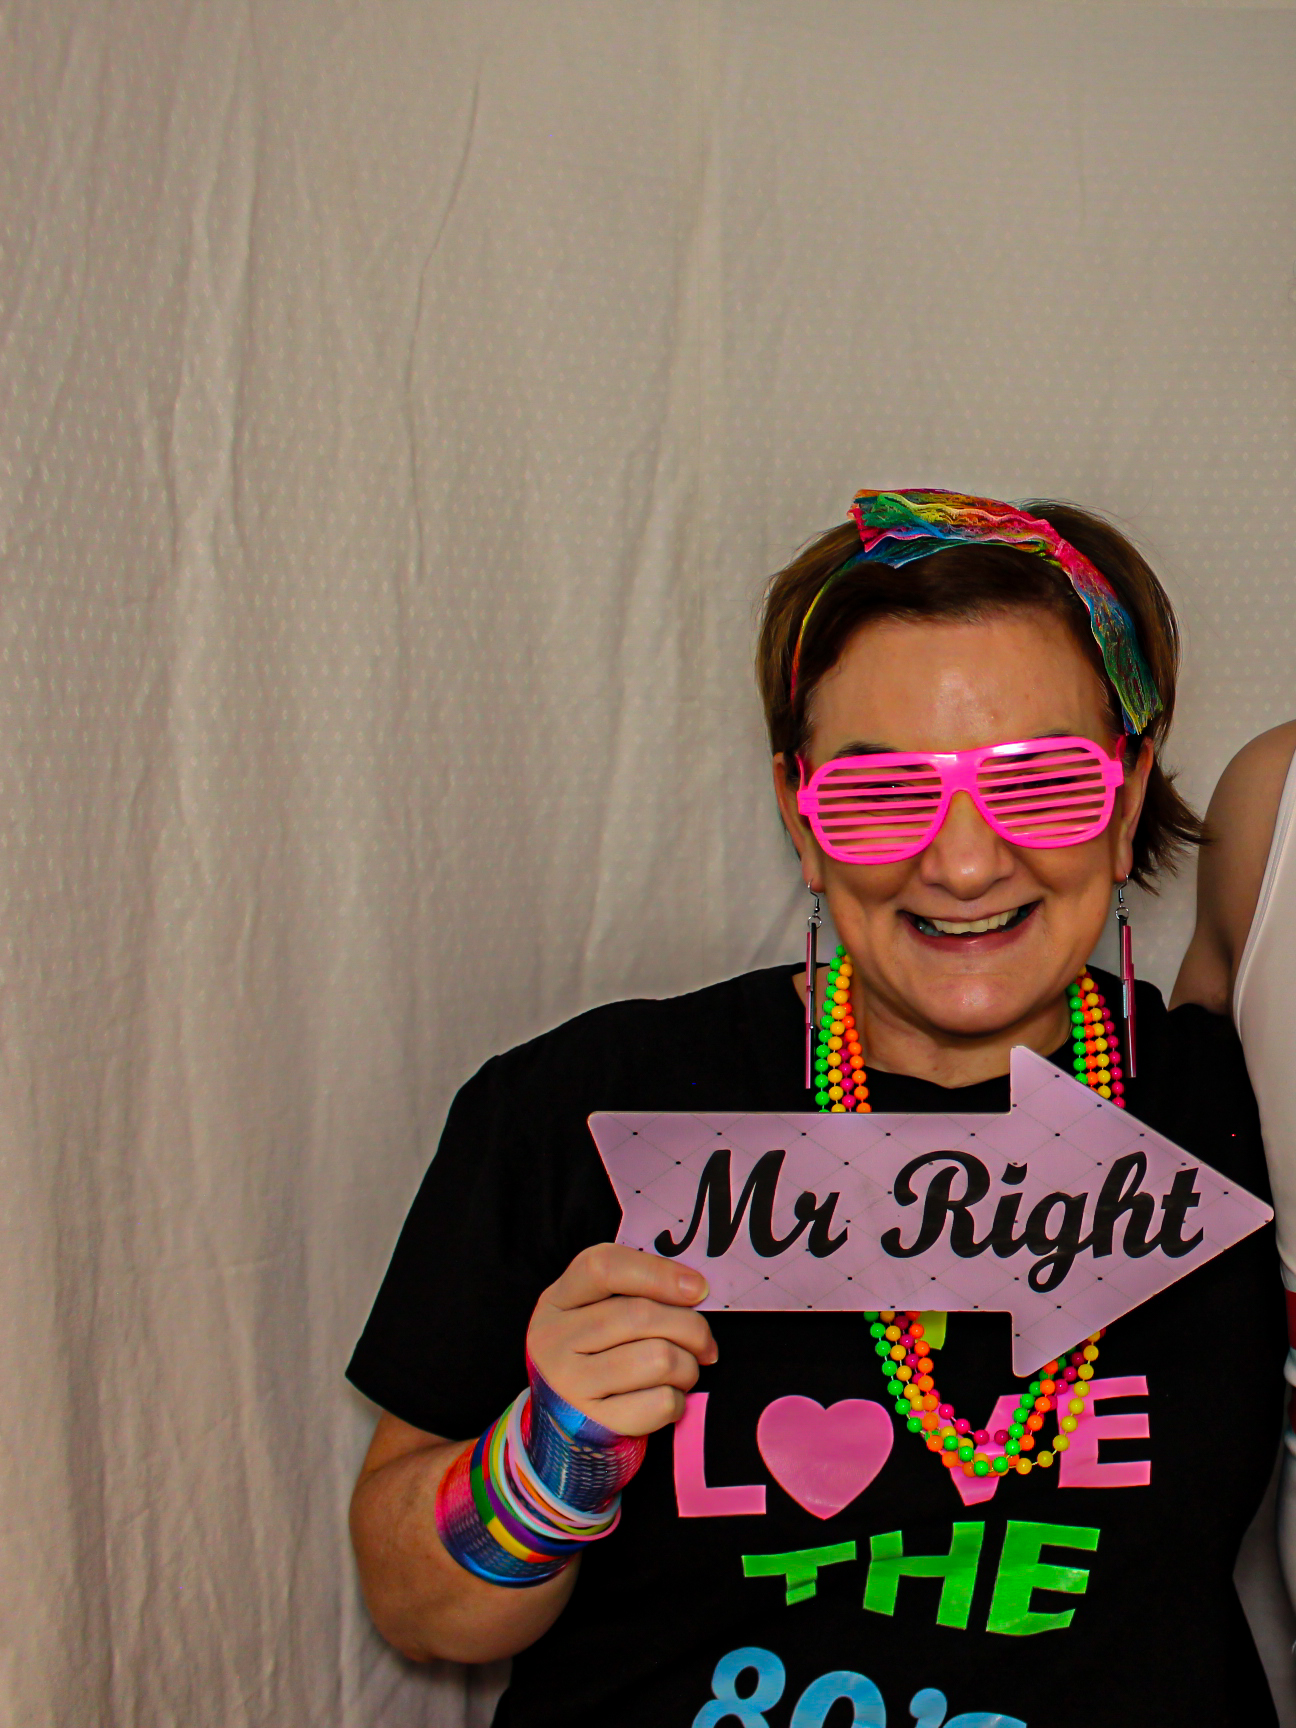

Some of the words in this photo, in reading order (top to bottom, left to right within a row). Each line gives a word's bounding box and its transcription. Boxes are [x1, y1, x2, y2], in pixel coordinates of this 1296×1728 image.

[653, 1148, 848, 1259] Mr
[880, 1149, 1204, 1294] Right
[741, 1520, 1101, 1637] THE
